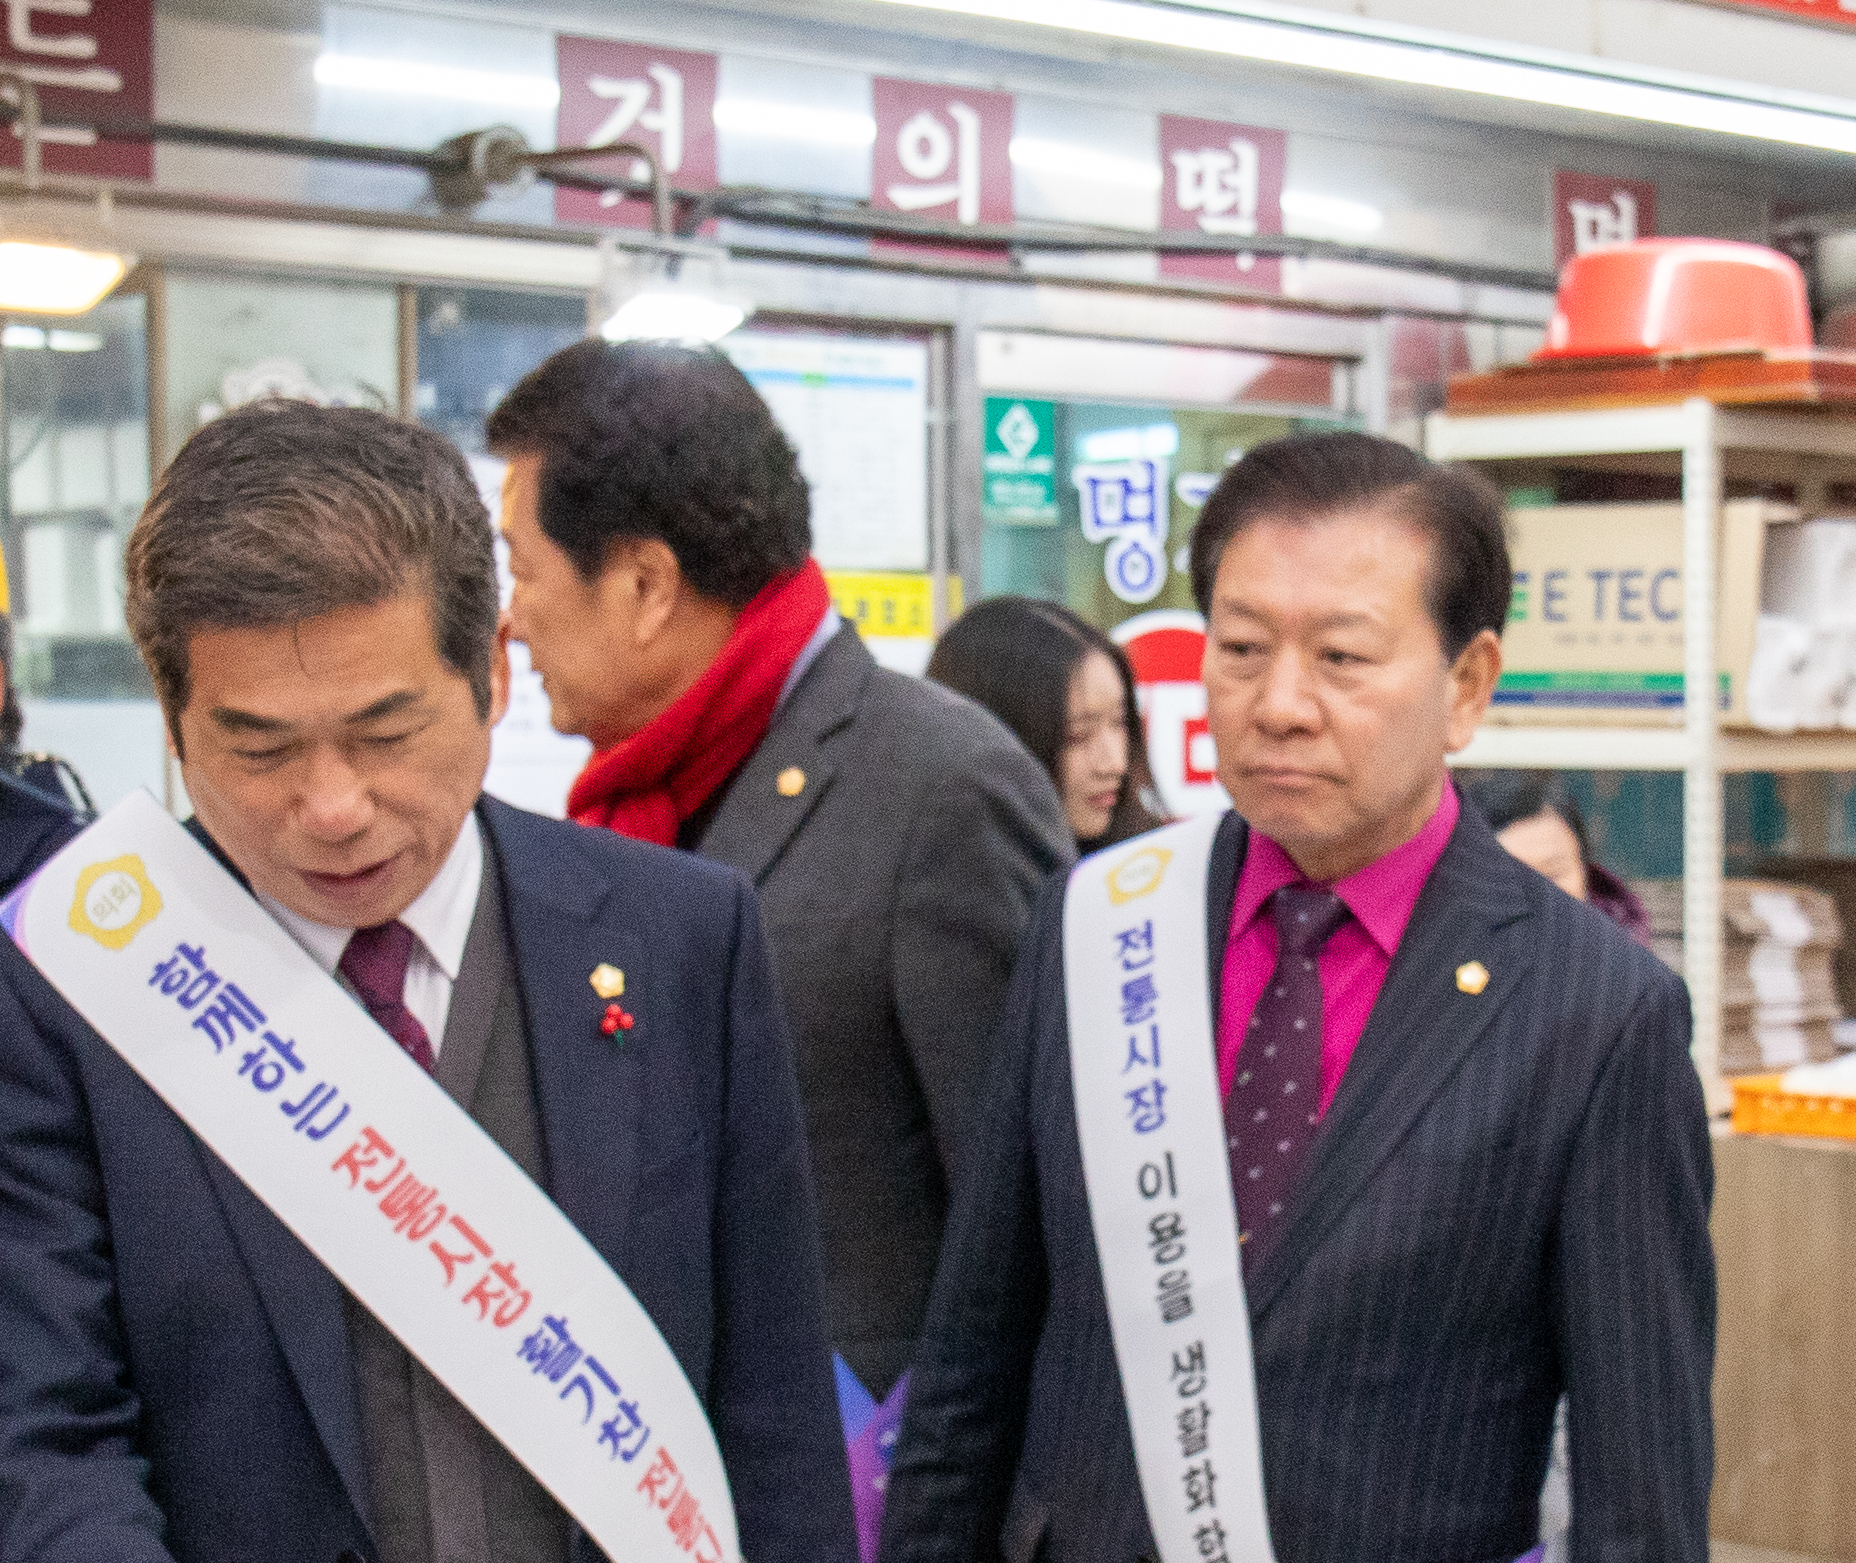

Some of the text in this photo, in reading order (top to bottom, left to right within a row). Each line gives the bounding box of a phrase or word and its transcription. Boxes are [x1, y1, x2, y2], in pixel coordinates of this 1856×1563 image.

[1112, 918, 1170, 1136] 전통시장
[145, 940, 353, 1141] 함께하는
[331, 1125, 533, 1330] 전통시장
[515, 1312, 653, 1464] 활기찬
[1134, 1148, 1199, 1326] 이용을
